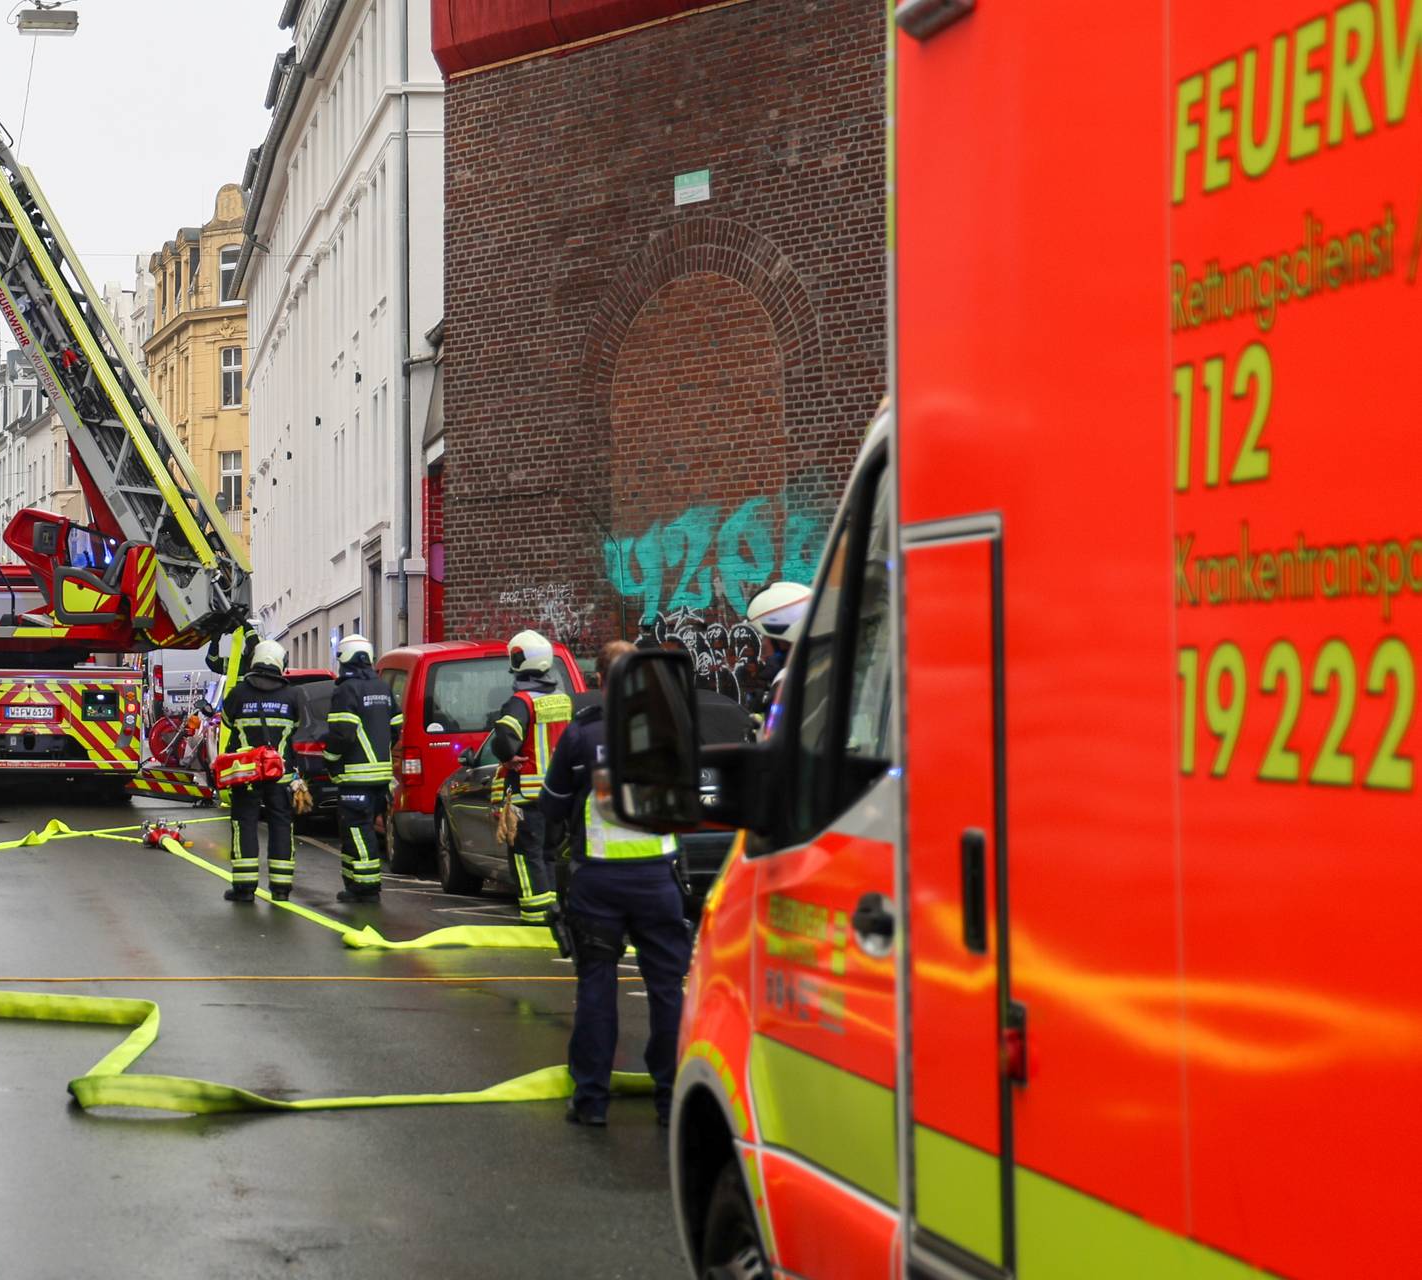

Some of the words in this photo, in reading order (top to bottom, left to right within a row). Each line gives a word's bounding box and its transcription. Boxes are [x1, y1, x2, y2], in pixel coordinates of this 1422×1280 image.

[1171, 203, 1394, 333] Rettungsdienst
[31, 351, 63, 401] WUPPERTAL
[1173, 341, 1273, 492] 112
